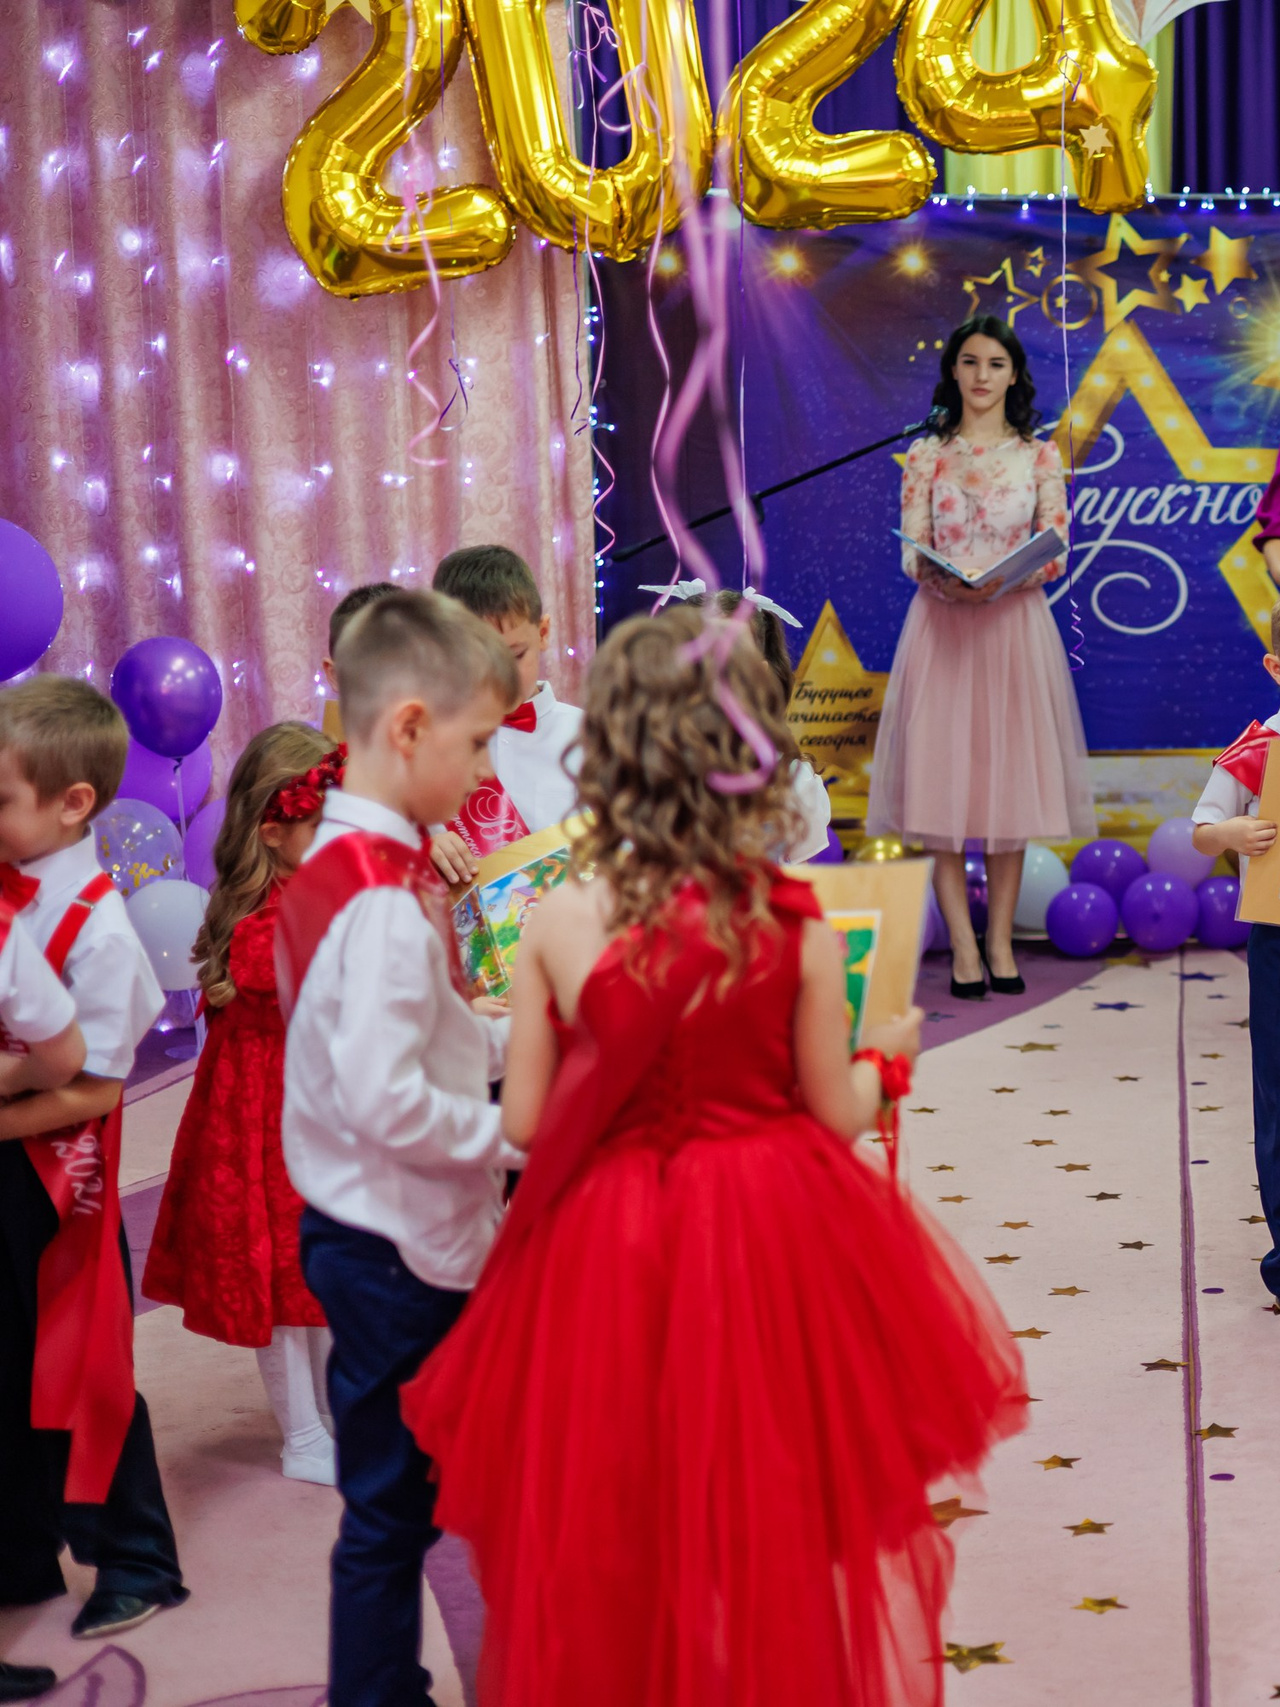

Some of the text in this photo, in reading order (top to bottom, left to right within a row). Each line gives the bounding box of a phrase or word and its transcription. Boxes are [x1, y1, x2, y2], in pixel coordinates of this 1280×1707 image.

[233, 0, 1158, 298] 2024
[795, 681, 873, 704] Будущее
[788, 707, 880, 723] ачинаетс
[799, 734, 867, 751] сегодня
